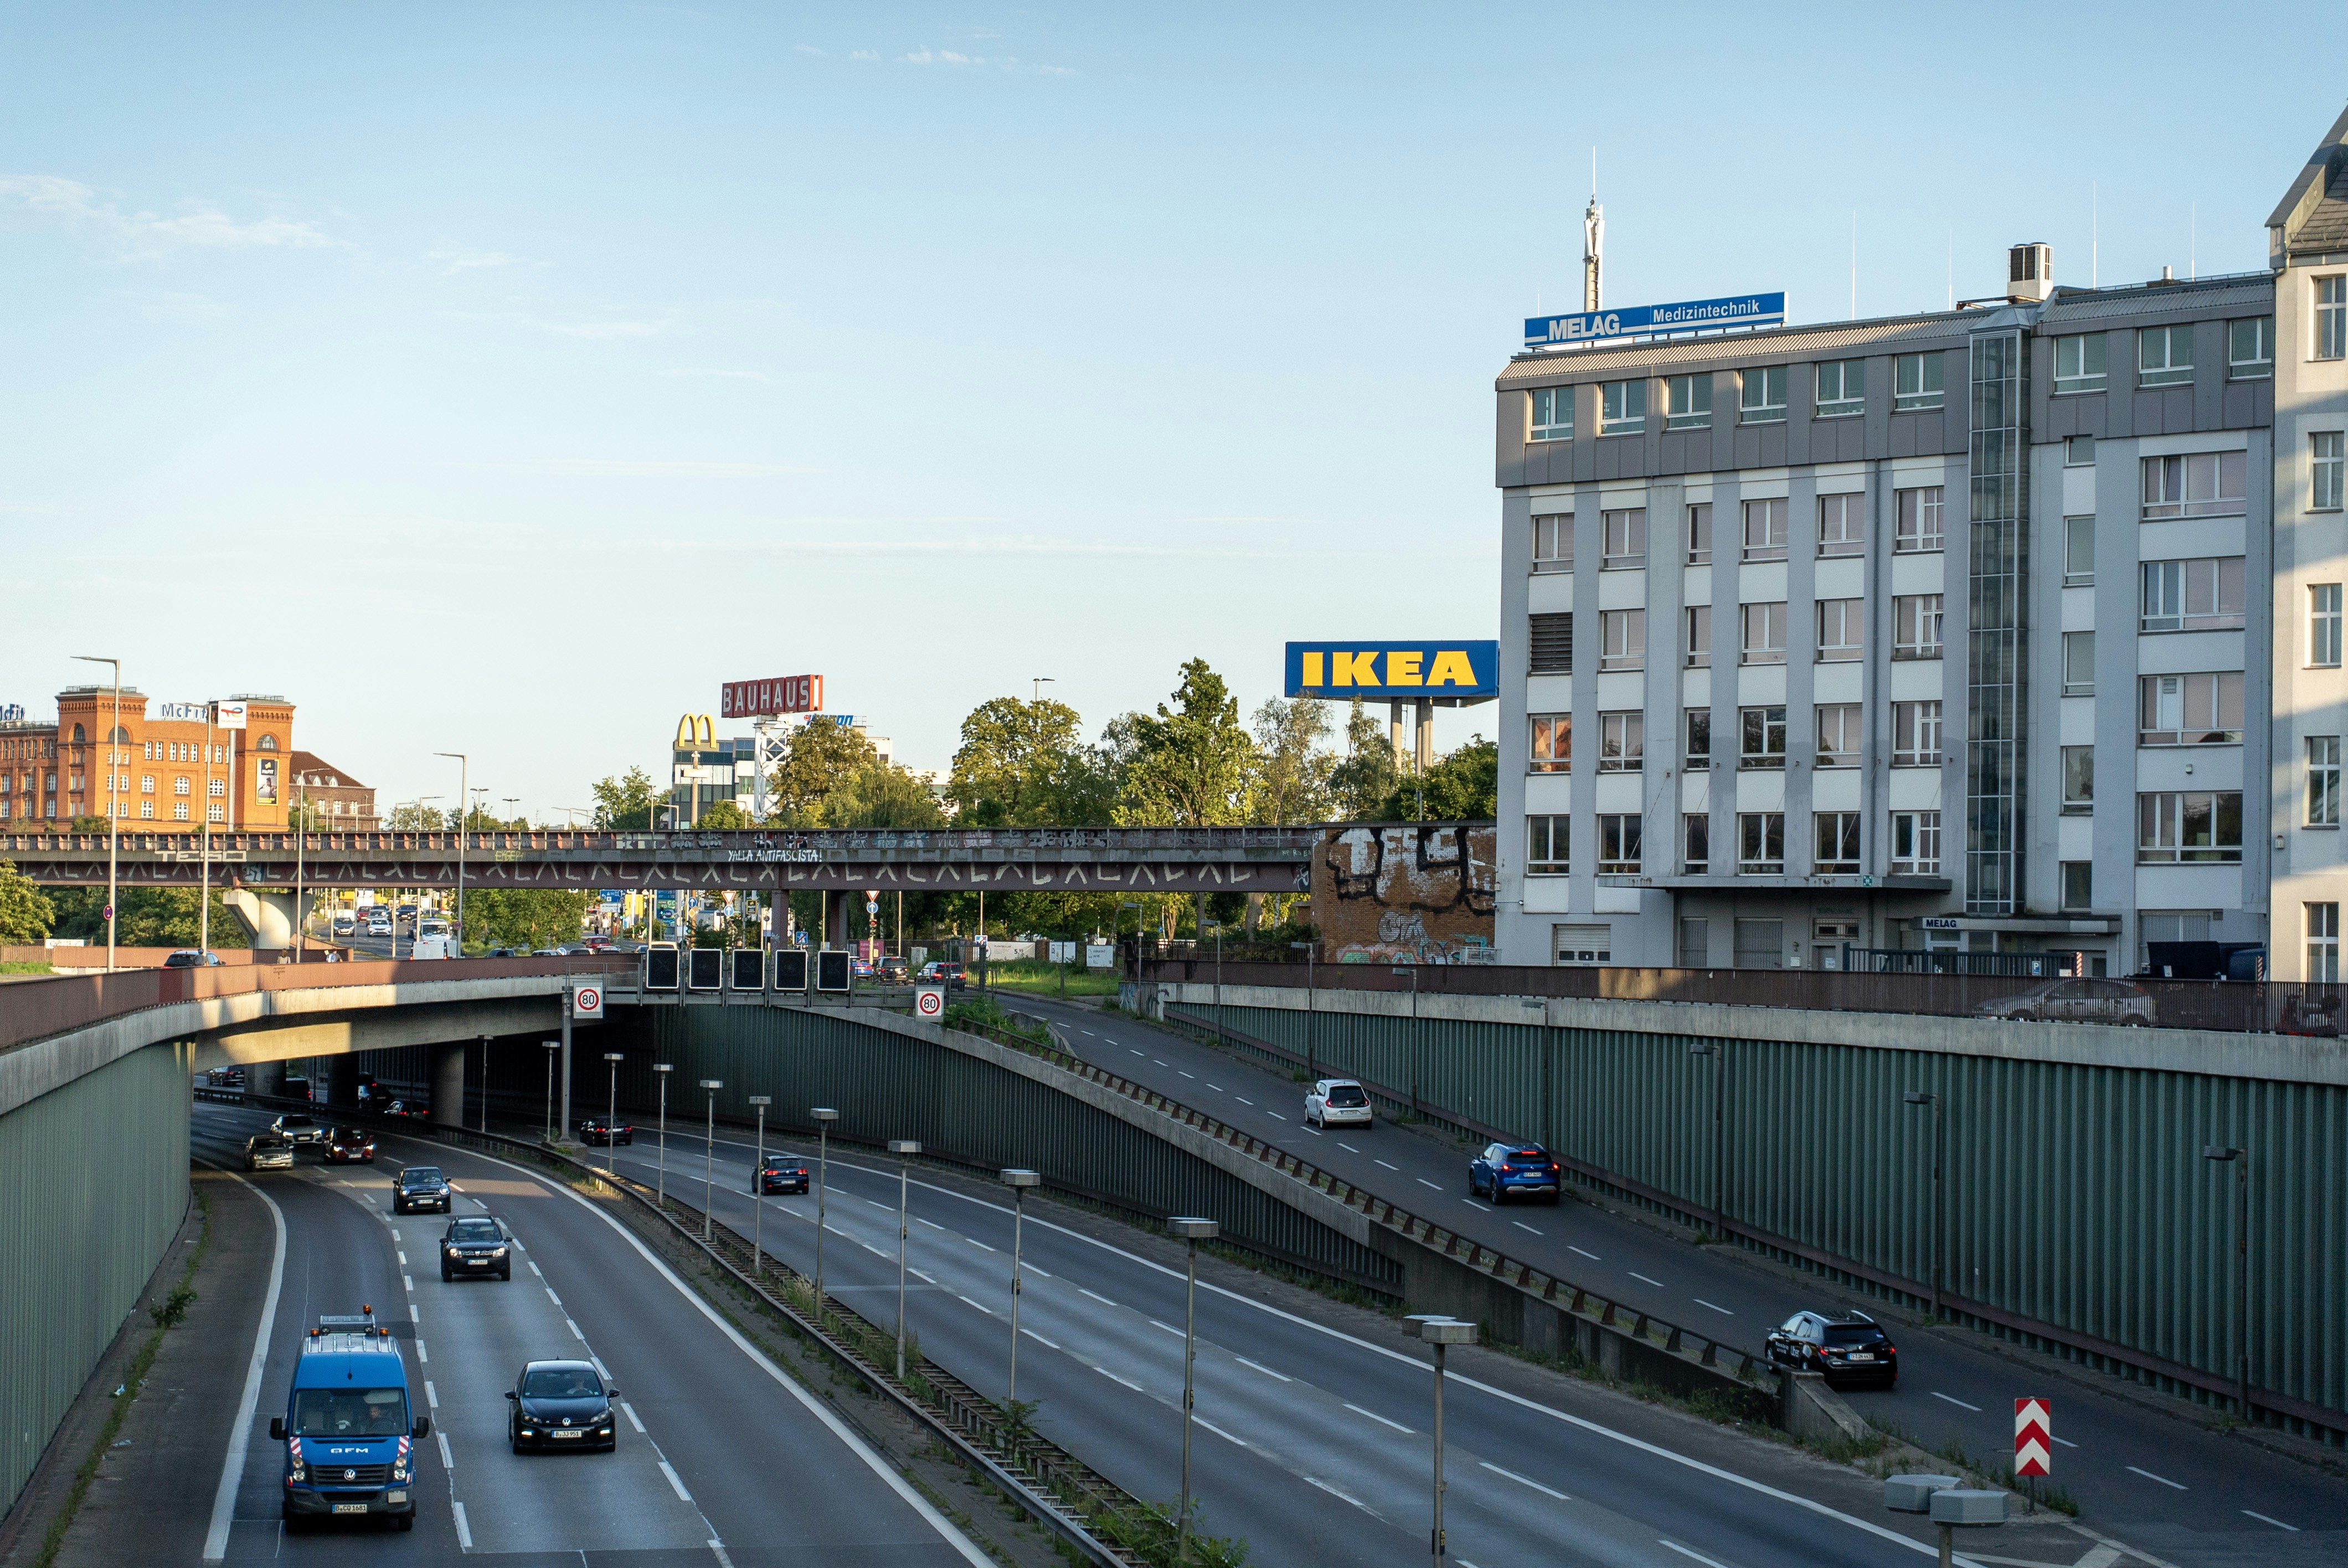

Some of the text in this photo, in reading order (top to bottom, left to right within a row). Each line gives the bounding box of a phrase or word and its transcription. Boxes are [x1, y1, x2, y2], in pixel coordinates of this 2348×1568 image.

[1548, 300, 1760, 341] MELAG Medizintechnik
[1302, 651, 1478, 687] IKEA
[723, 680, 809, 713] BAUHAUS
[728, 850, 753, 862] YALLA
[581, 994, 595, 1004] 80
[923, 998, 936, 1009] 80
[1790, 1345, 1800, 1357] Uber
